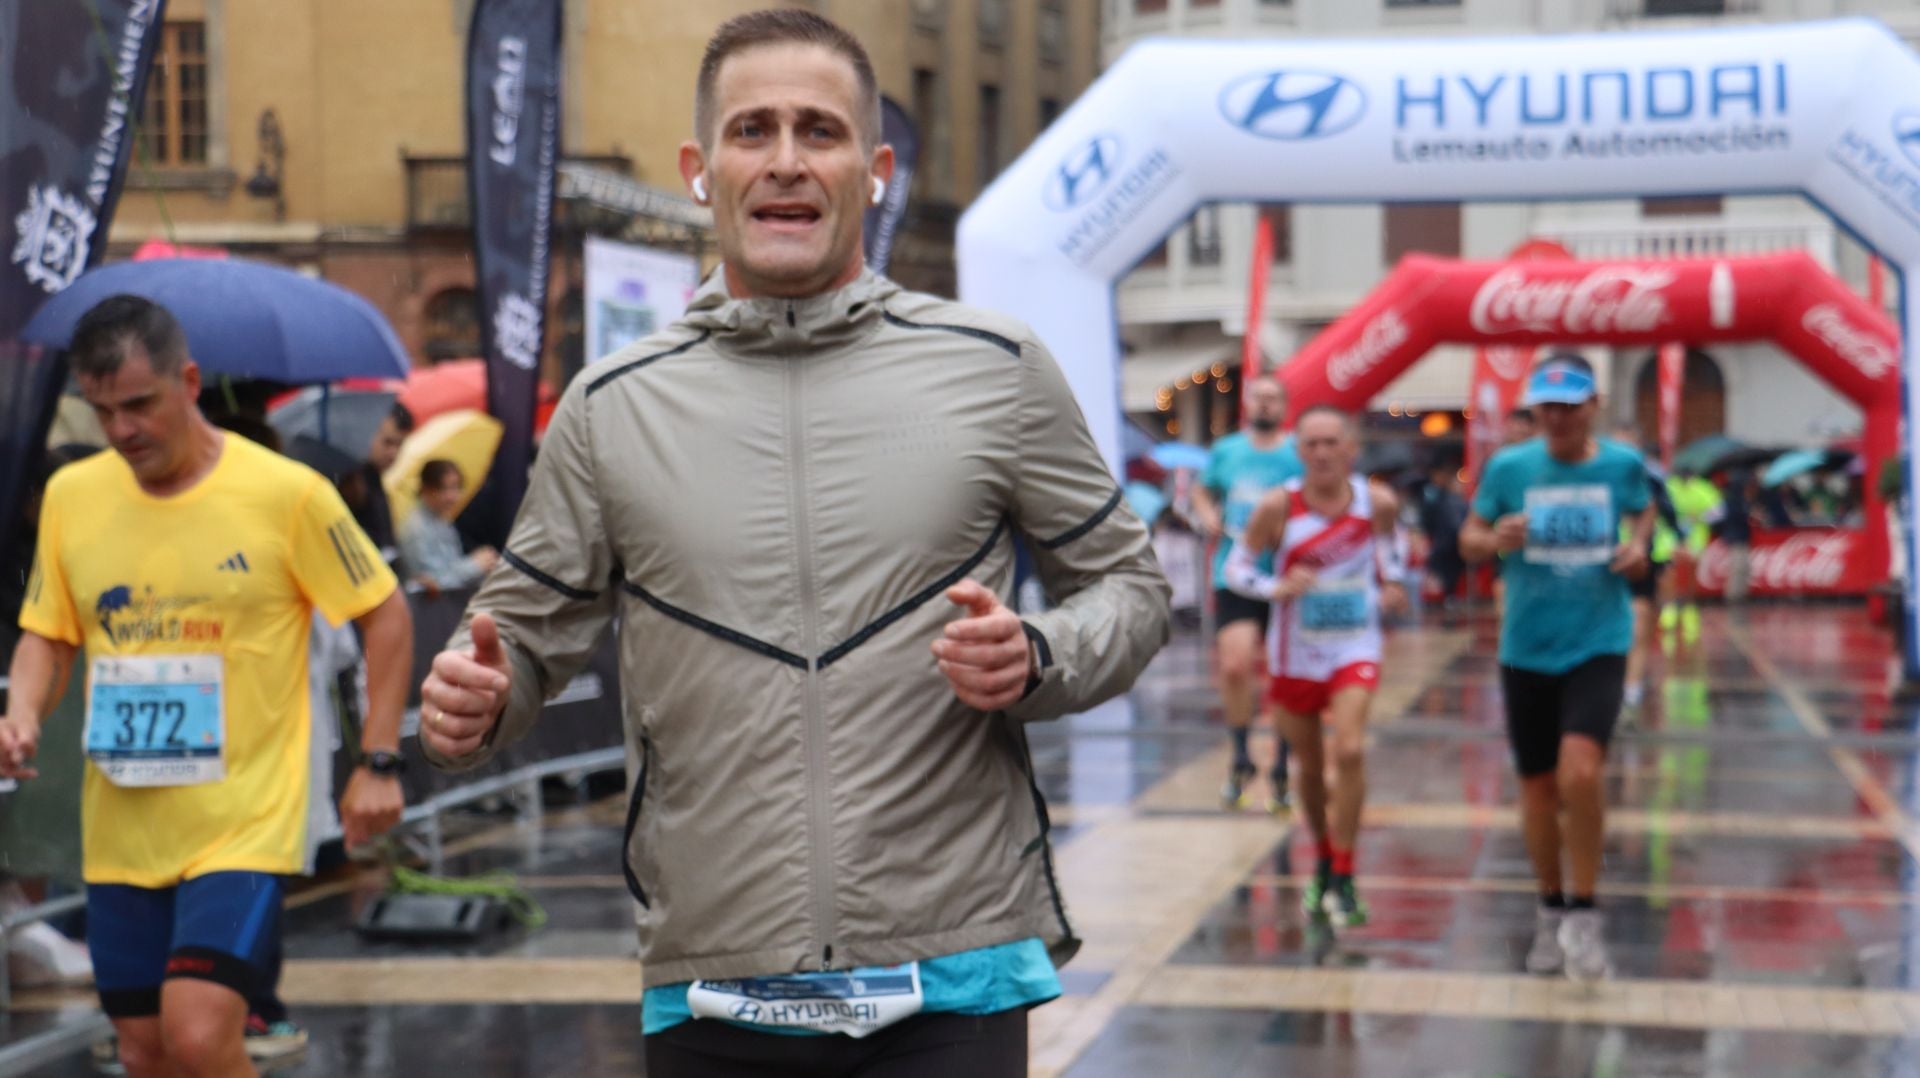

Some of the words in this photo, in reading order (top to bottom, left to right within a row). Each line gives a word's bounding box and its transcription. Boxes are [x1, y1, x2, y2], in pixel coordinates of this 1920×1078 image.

[1394, 63, 1787, 127] HYUNDAI
[1393, 134, 1551, 164] Lemauto
[1562, 124, 1790, 161] Automoción
[115, 701, 187, 749] 372
[771, 1002, 878, 1022] HYUNDAI
